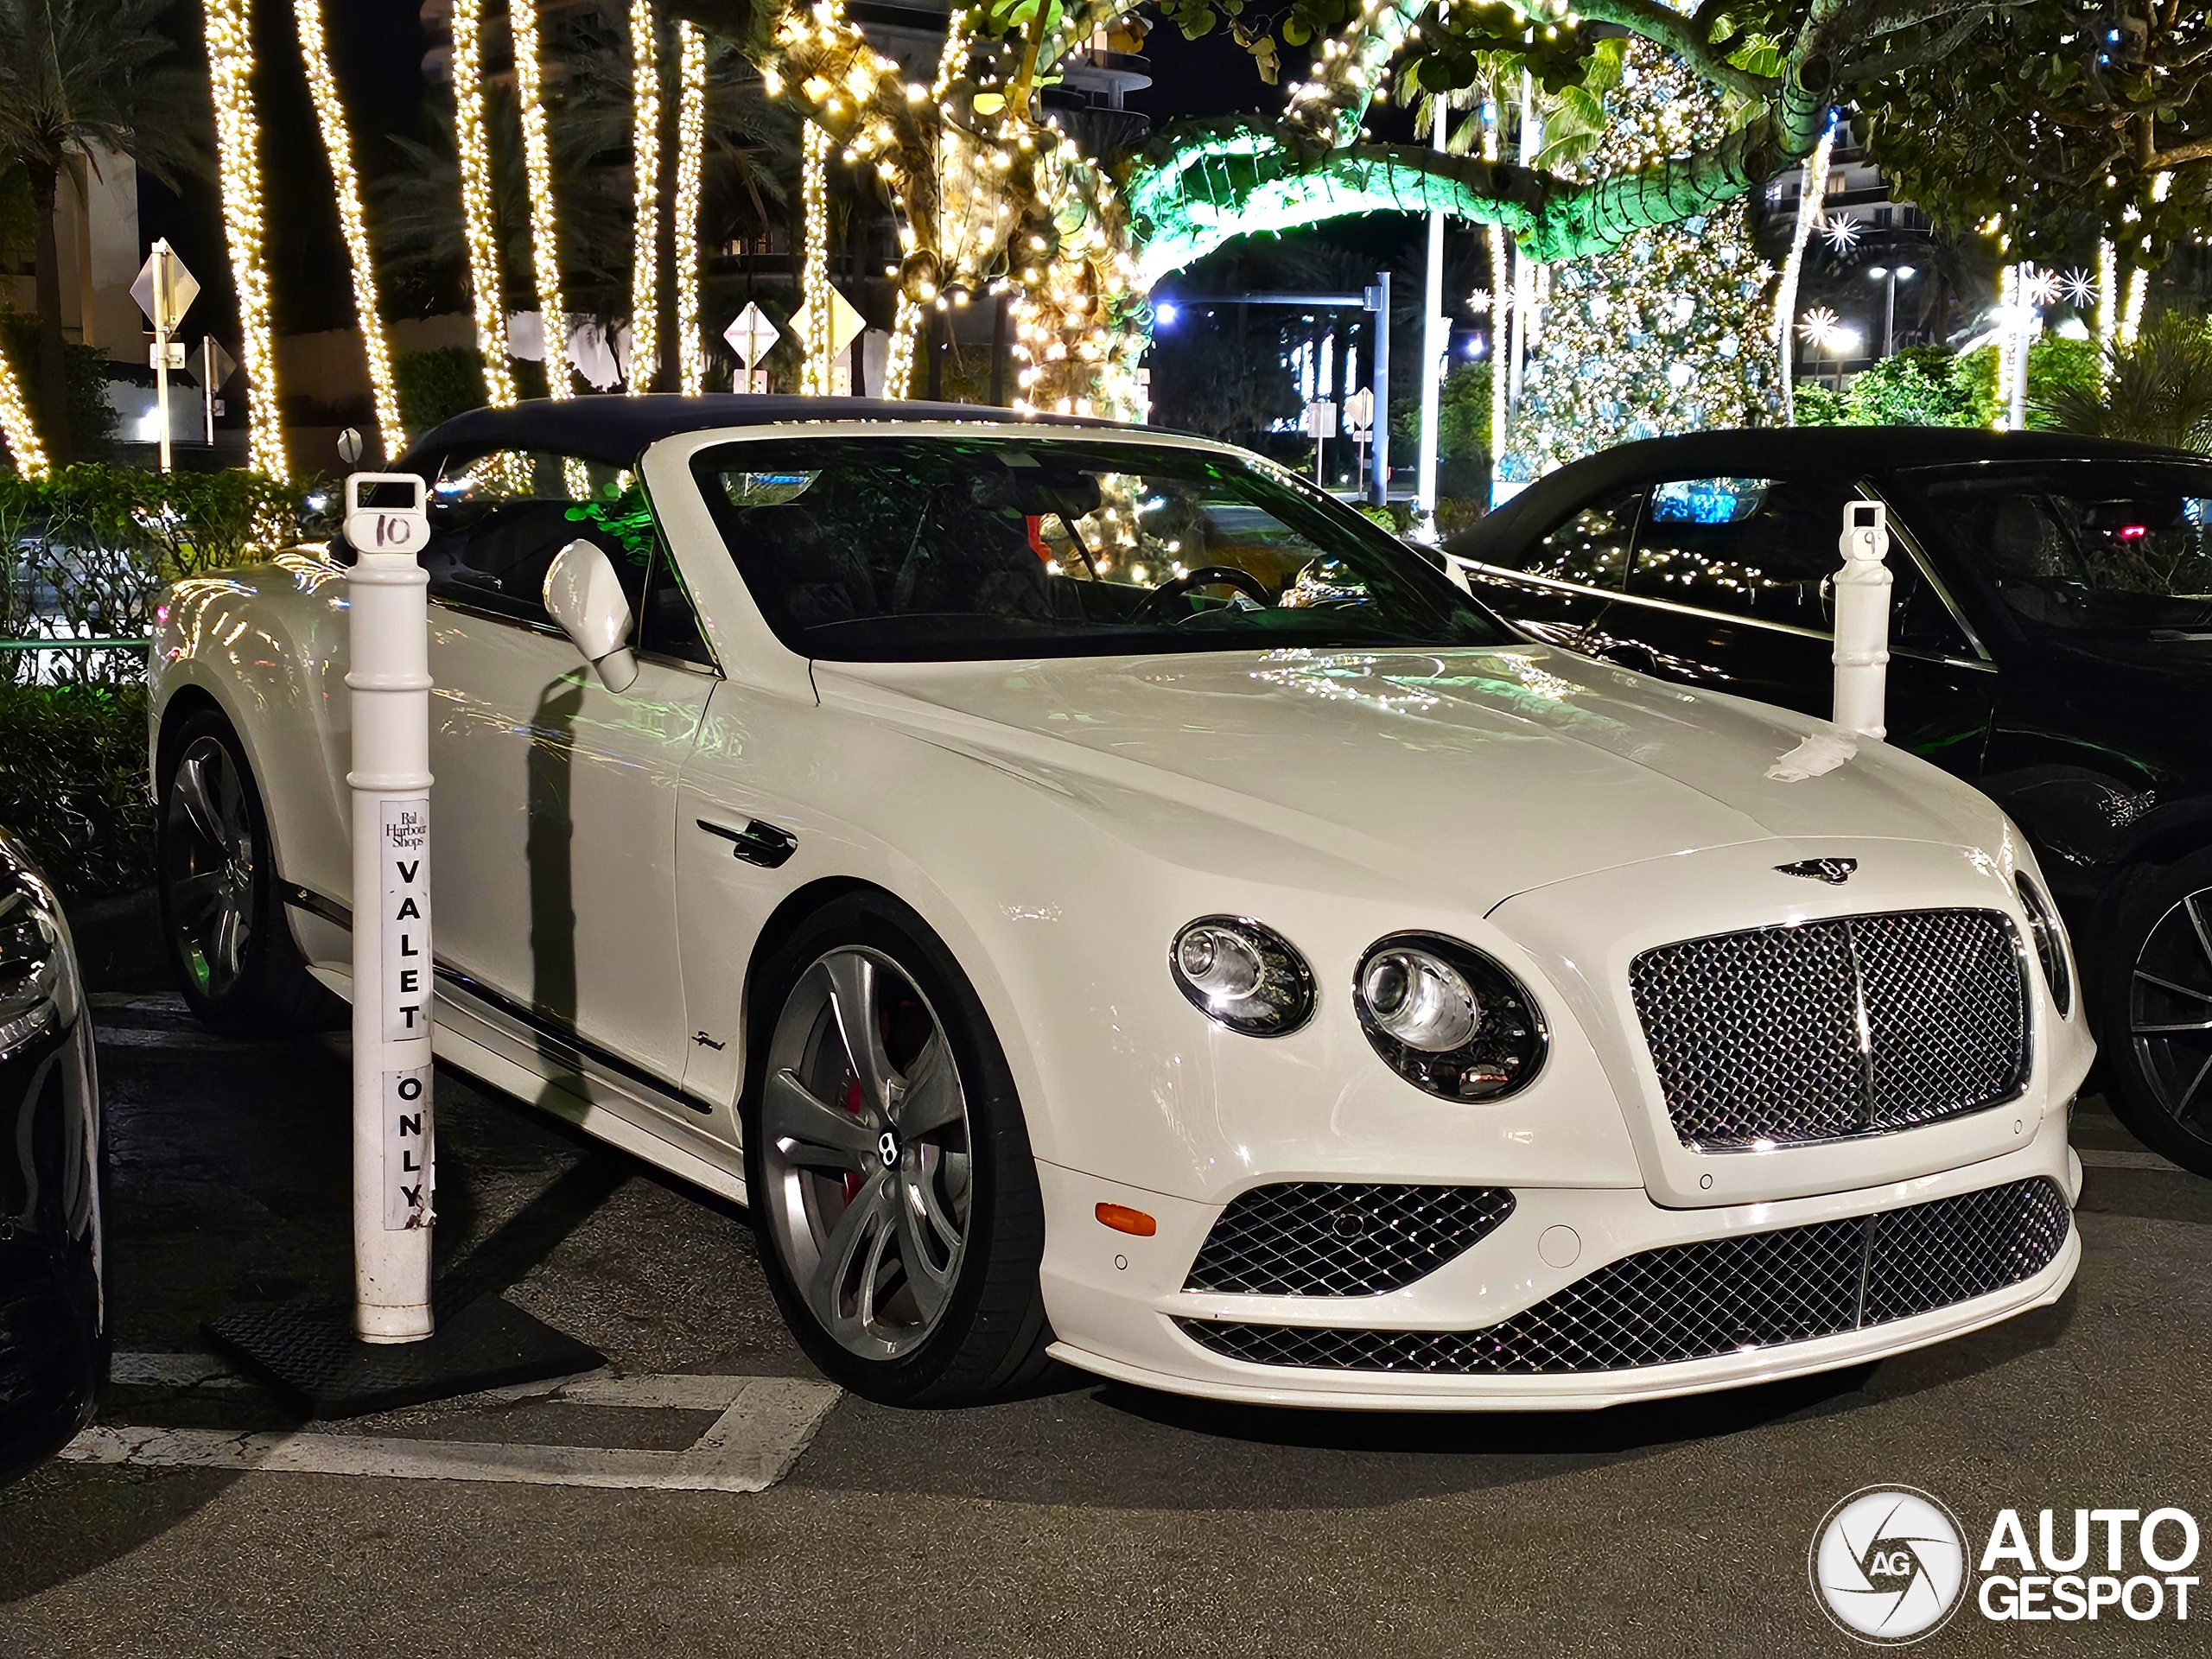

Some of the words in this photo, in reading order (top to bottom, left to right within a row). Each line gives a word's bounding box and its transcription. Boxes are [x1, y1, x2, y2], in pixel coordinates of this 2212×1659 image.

[376, 514, 410, 547] 10
[1864, 530, 1876, 555] 9
[386, 823, 427, 836] Harbour
[401, 811, 417, 824] Bal
[392, 836, 424, 851] Shops
[396, 860, 421, 1029] VALET
[397, 1077, 423, 1207] ONLY
